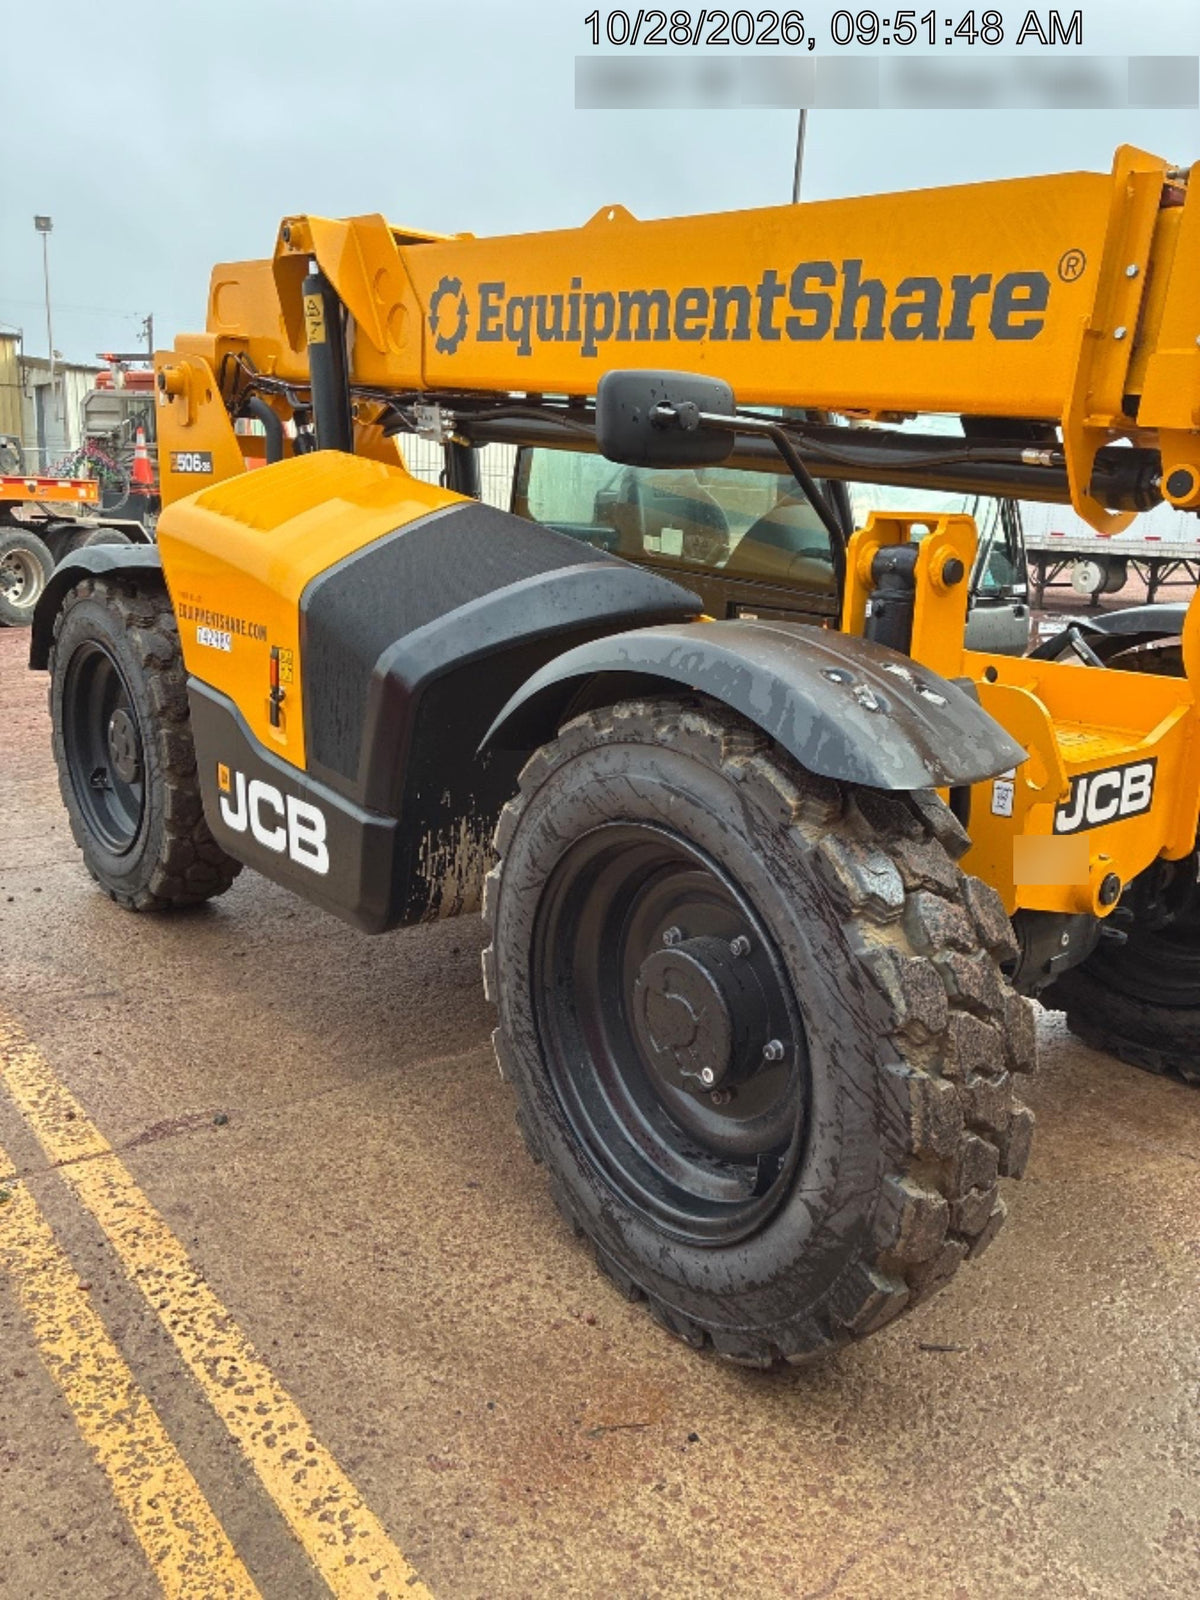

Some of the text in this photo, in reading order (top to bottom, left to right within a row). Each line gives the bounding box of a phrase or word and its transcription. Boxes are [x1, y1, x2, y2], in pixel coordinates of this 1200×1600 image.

[476, 258, 1051, 358] EquipmentShare
[178, 602, 268, 642] EQUIPMENTSHARE.COM
[220, 770, 330, 875] JCB
[1055, 763, 1154, 832] JCB
